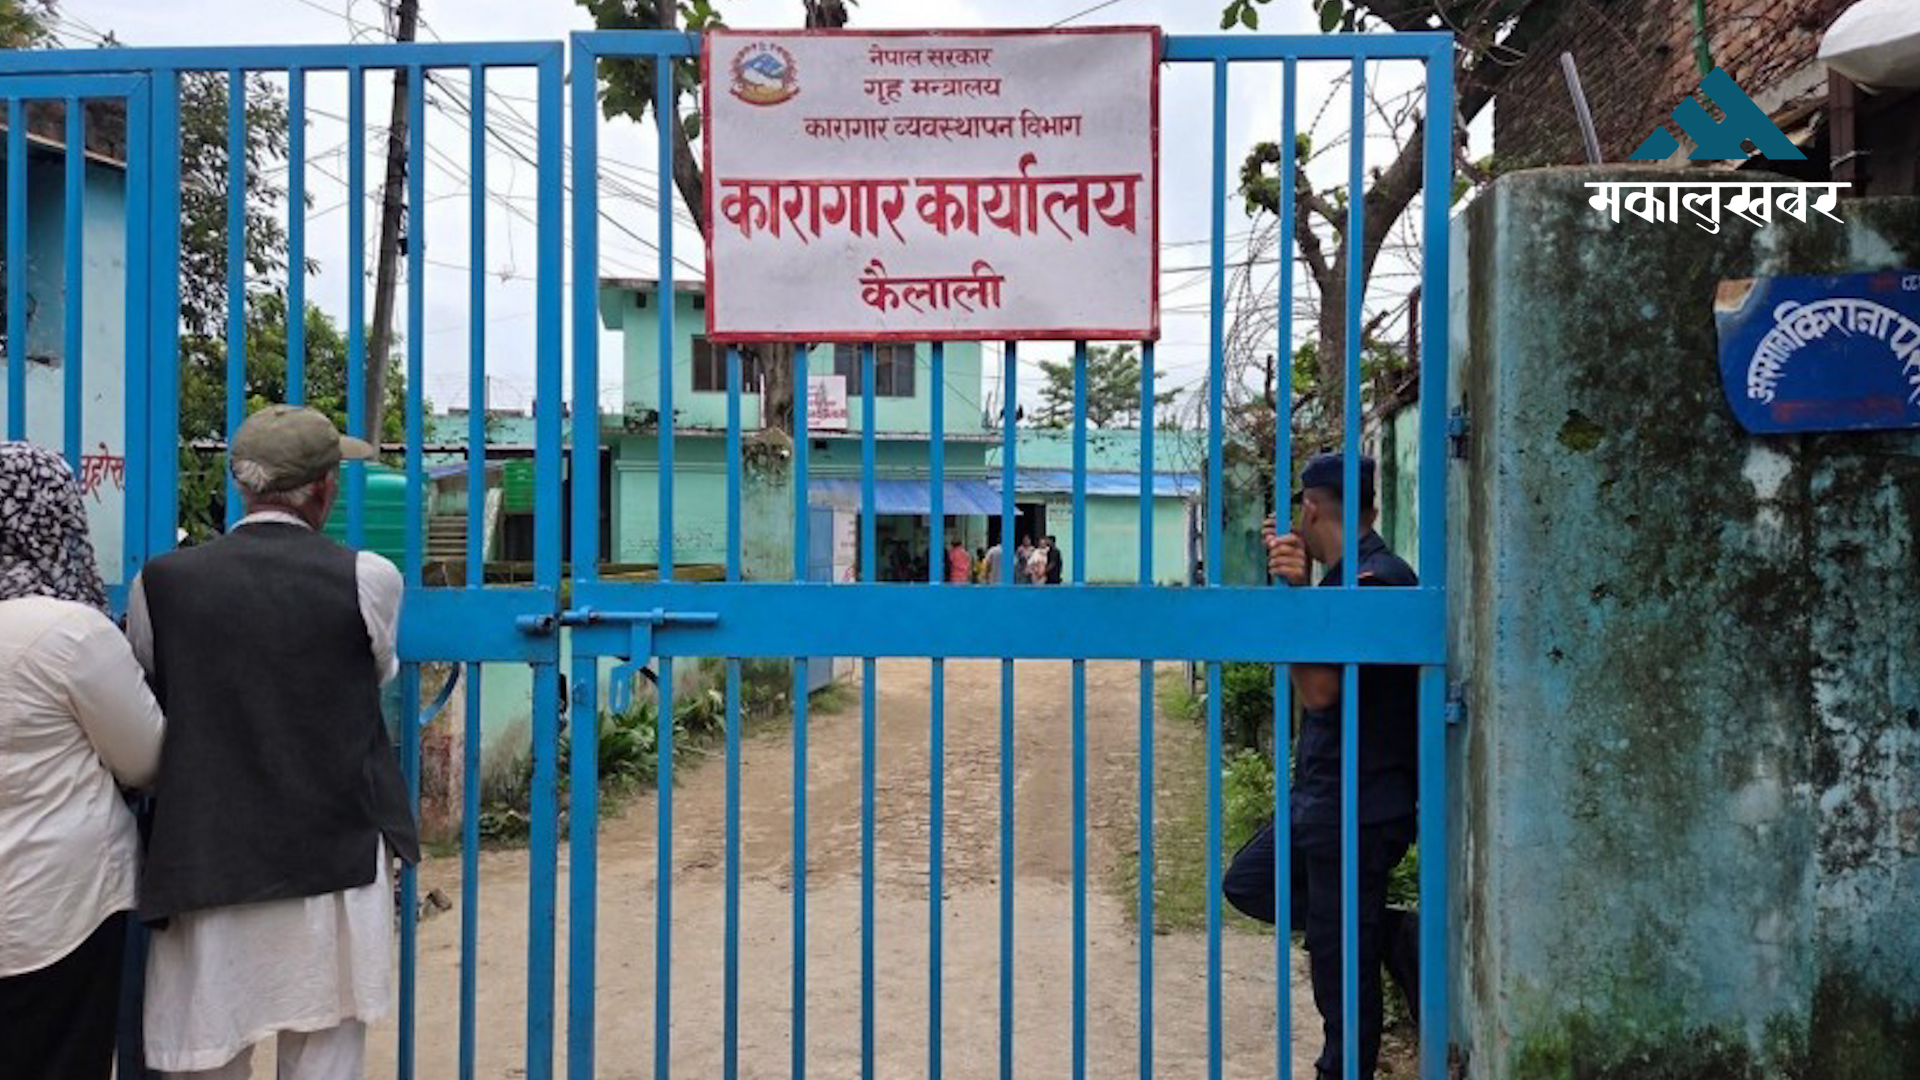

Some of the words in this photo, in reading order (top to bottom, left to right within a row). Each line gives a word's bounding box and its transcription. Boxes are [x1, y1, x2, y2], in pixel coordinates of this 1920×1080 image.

[868, 43, 923, 67] नेपाल
[926, 47, 993, 67] सरकार
[863, 78, 904, 105] गृह
[910, 78, 1002, 98] मन्त्रालय
[804, 116, 890, 142] कारागार
[892, 115, 1015, 142] व्यवस्थापन
[1018, 108, 1083, 139] विभाग
[719, 178, 909, 245] कारागार
[915, 152, 1143, 242] कार्यालय
[859, 258, 1005, 313] कैलाली
[1773, 298, 1900, 348] किराना
